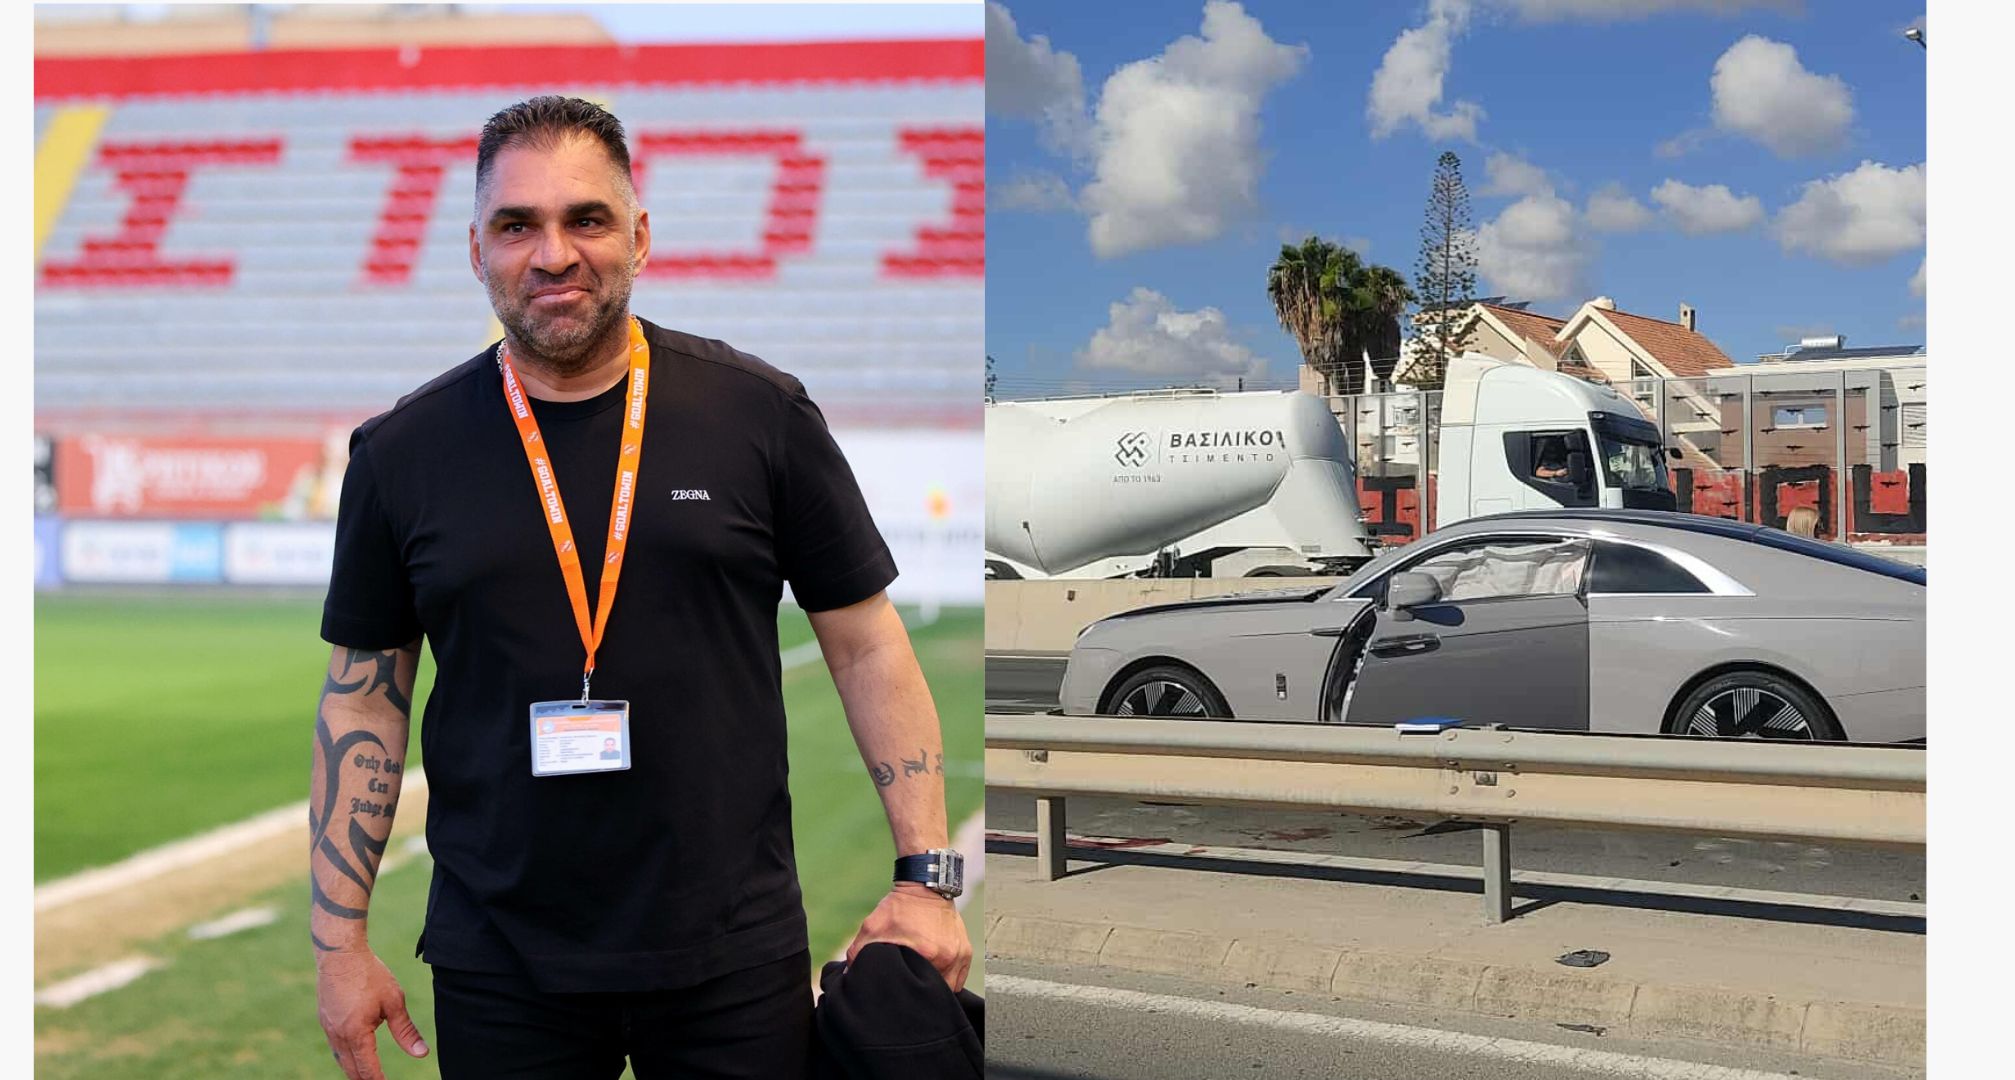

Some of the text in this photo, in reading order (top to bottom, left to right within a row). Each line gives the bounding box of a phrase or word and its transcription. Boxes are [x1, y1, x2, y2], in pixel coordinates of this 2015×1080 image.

[630, 367, 645, 429] #GOALTOWIN
[535, 457, 563, 524] #GOALTOWIN
[671, 489, 711, 501] ZEGNA
[614, 470, 633, 540] #GOALTOWIN
[353, 754, 381, 774] Only
[368, 777, 389, 794] Can
[349, 797, 382, 818] Judge
